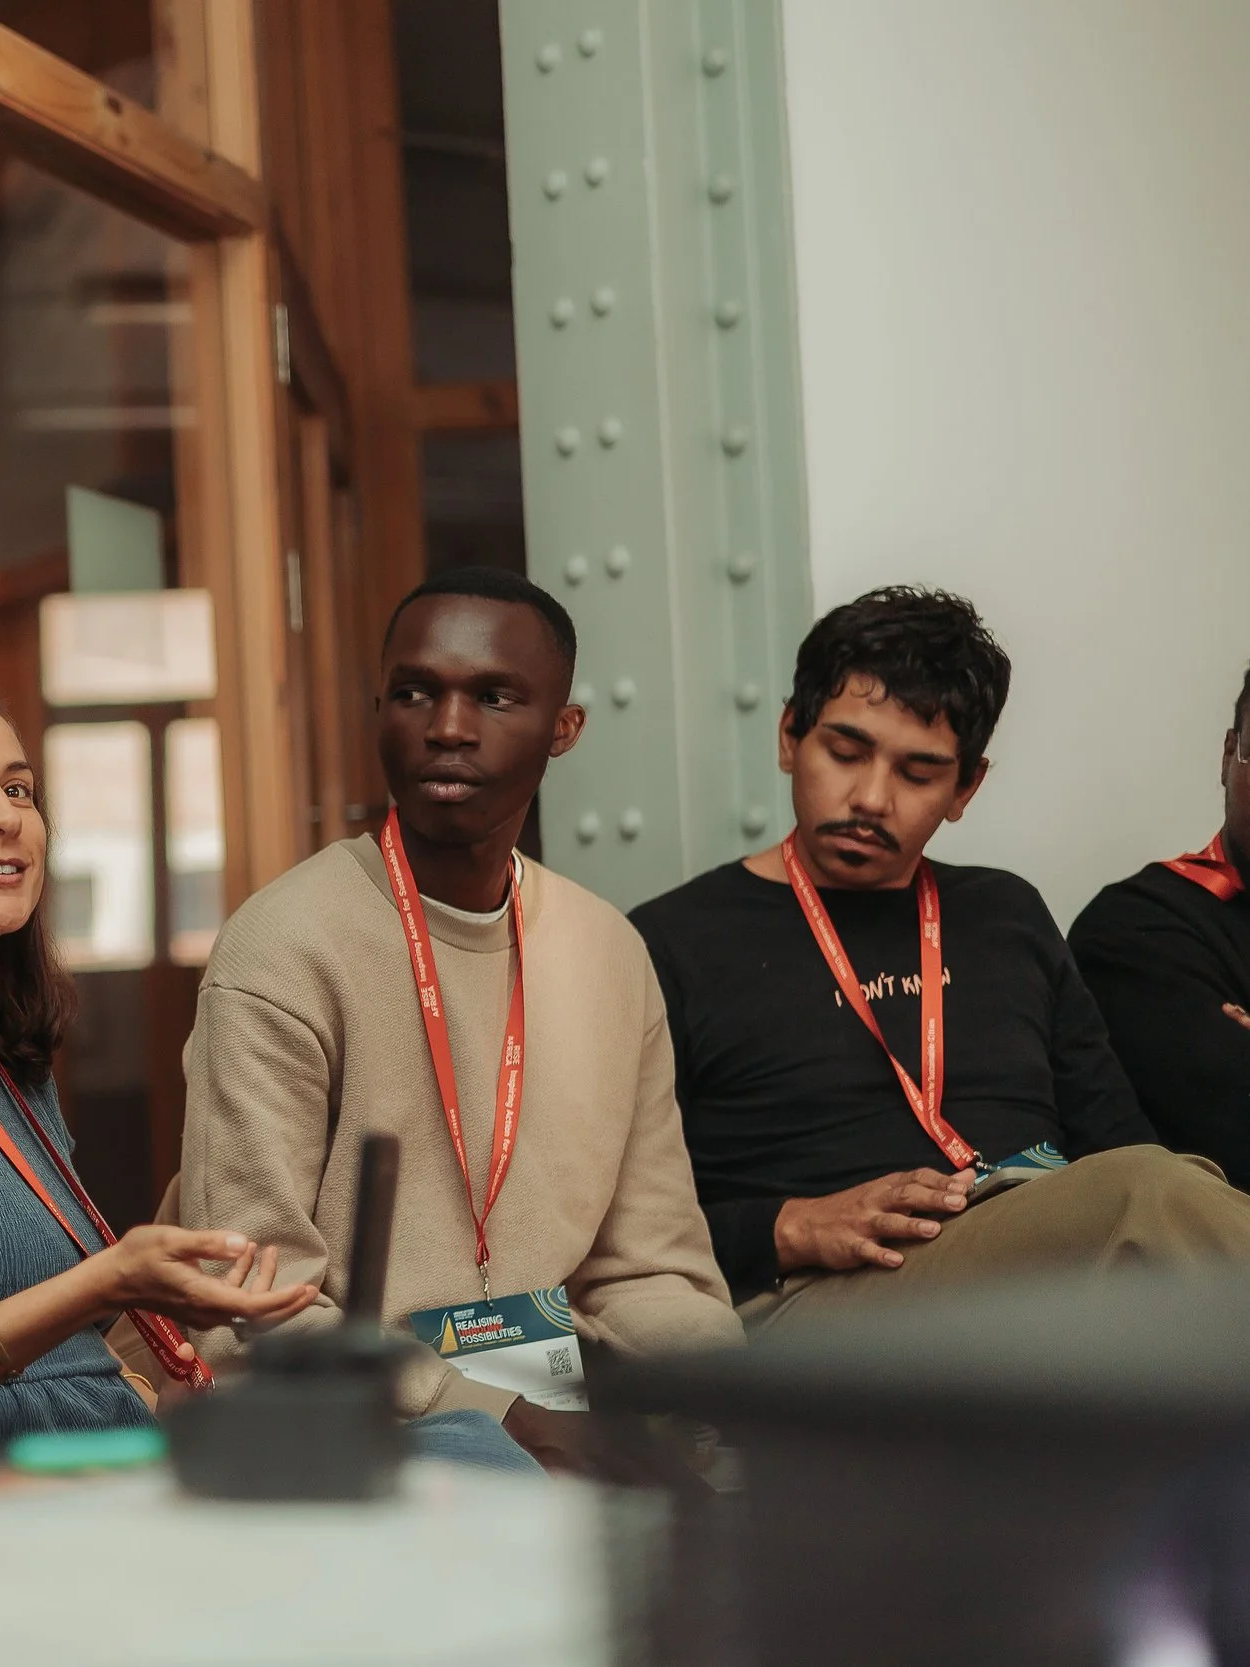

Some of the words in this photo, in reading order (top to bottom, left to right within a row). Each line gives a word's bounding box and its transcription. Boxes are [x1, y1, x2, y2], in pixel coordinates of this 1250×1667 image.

[389, 849, 407, 897] Sustainable
[402, 898, 410, 911] for
[406, 912, 418, 941] Action
[414, 942, 426, 982] Inspiring
[420, 987, 430, 1008] RISE
[428, 984, 440, 1018] AFRICA
[835, 990, 842, 1008] I
[504, 1070, 518, 1109] Inspiring
[450, 1108, 459, 1137] Cities
[504, 1109, 514, 1137] Action
[502, 1138, 510, 1153] for
[455, 1314, 504, 1331] REALISING
[459, 1325, 523, 1345] POSSIBILITIES
